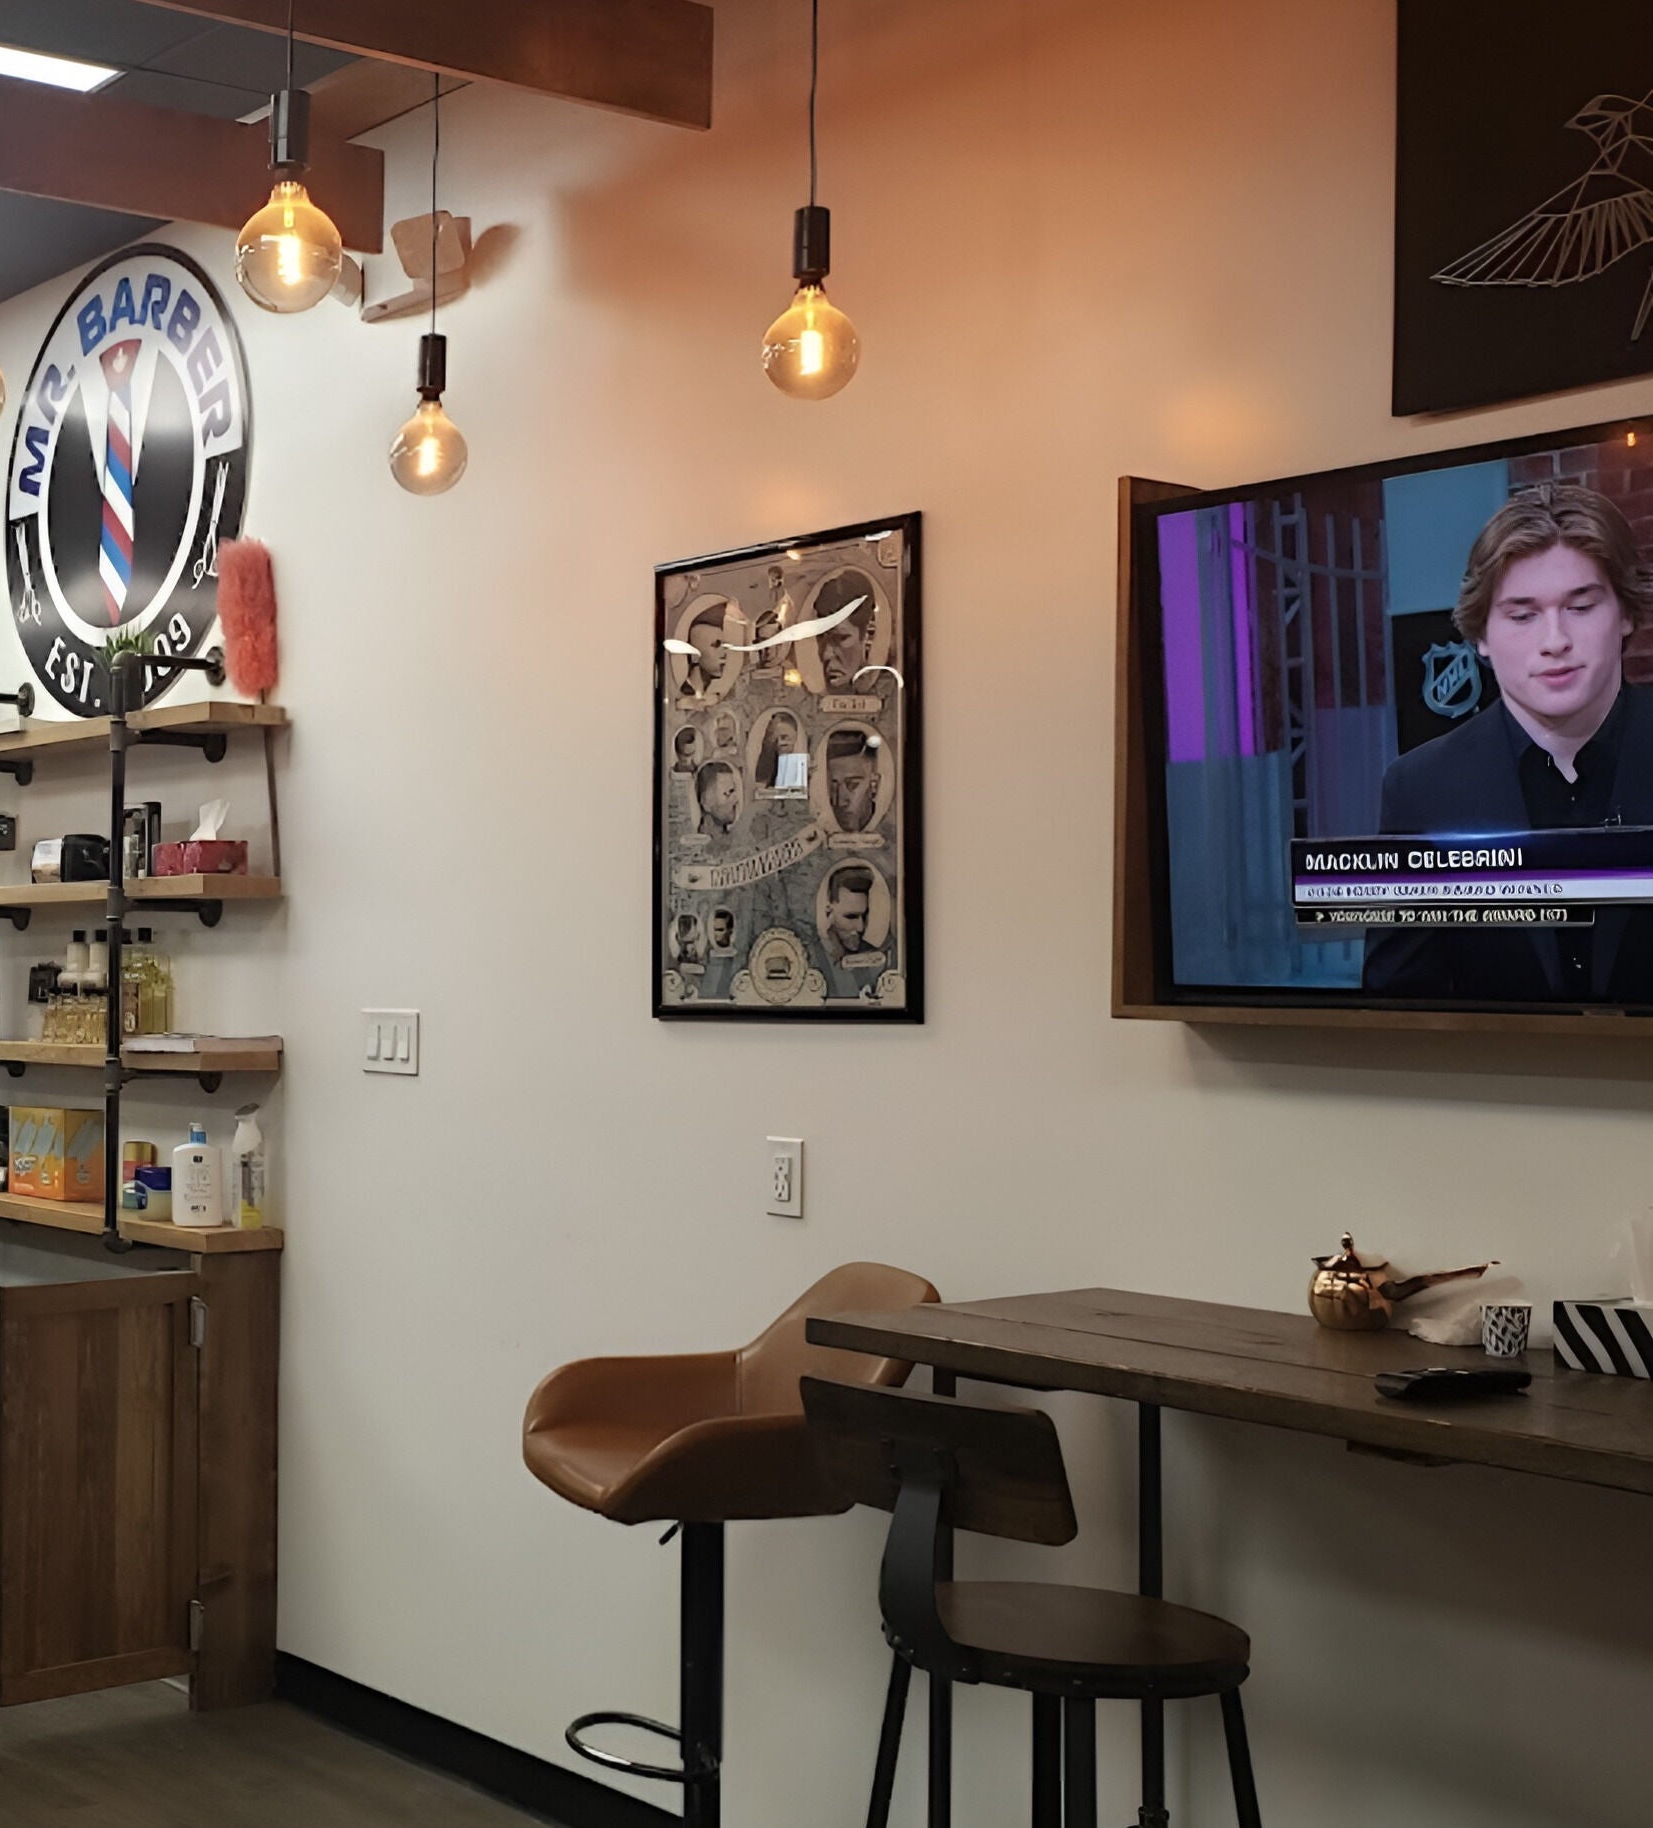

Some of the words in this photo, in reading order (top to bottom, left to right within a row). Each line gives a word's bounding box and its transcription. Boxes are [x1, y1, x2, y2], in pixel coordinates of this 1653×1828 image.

[19, 362, 76, 497] MR.
[76, 273, 232, 448] BARBER
[44, 636, 101, 708] EST.
